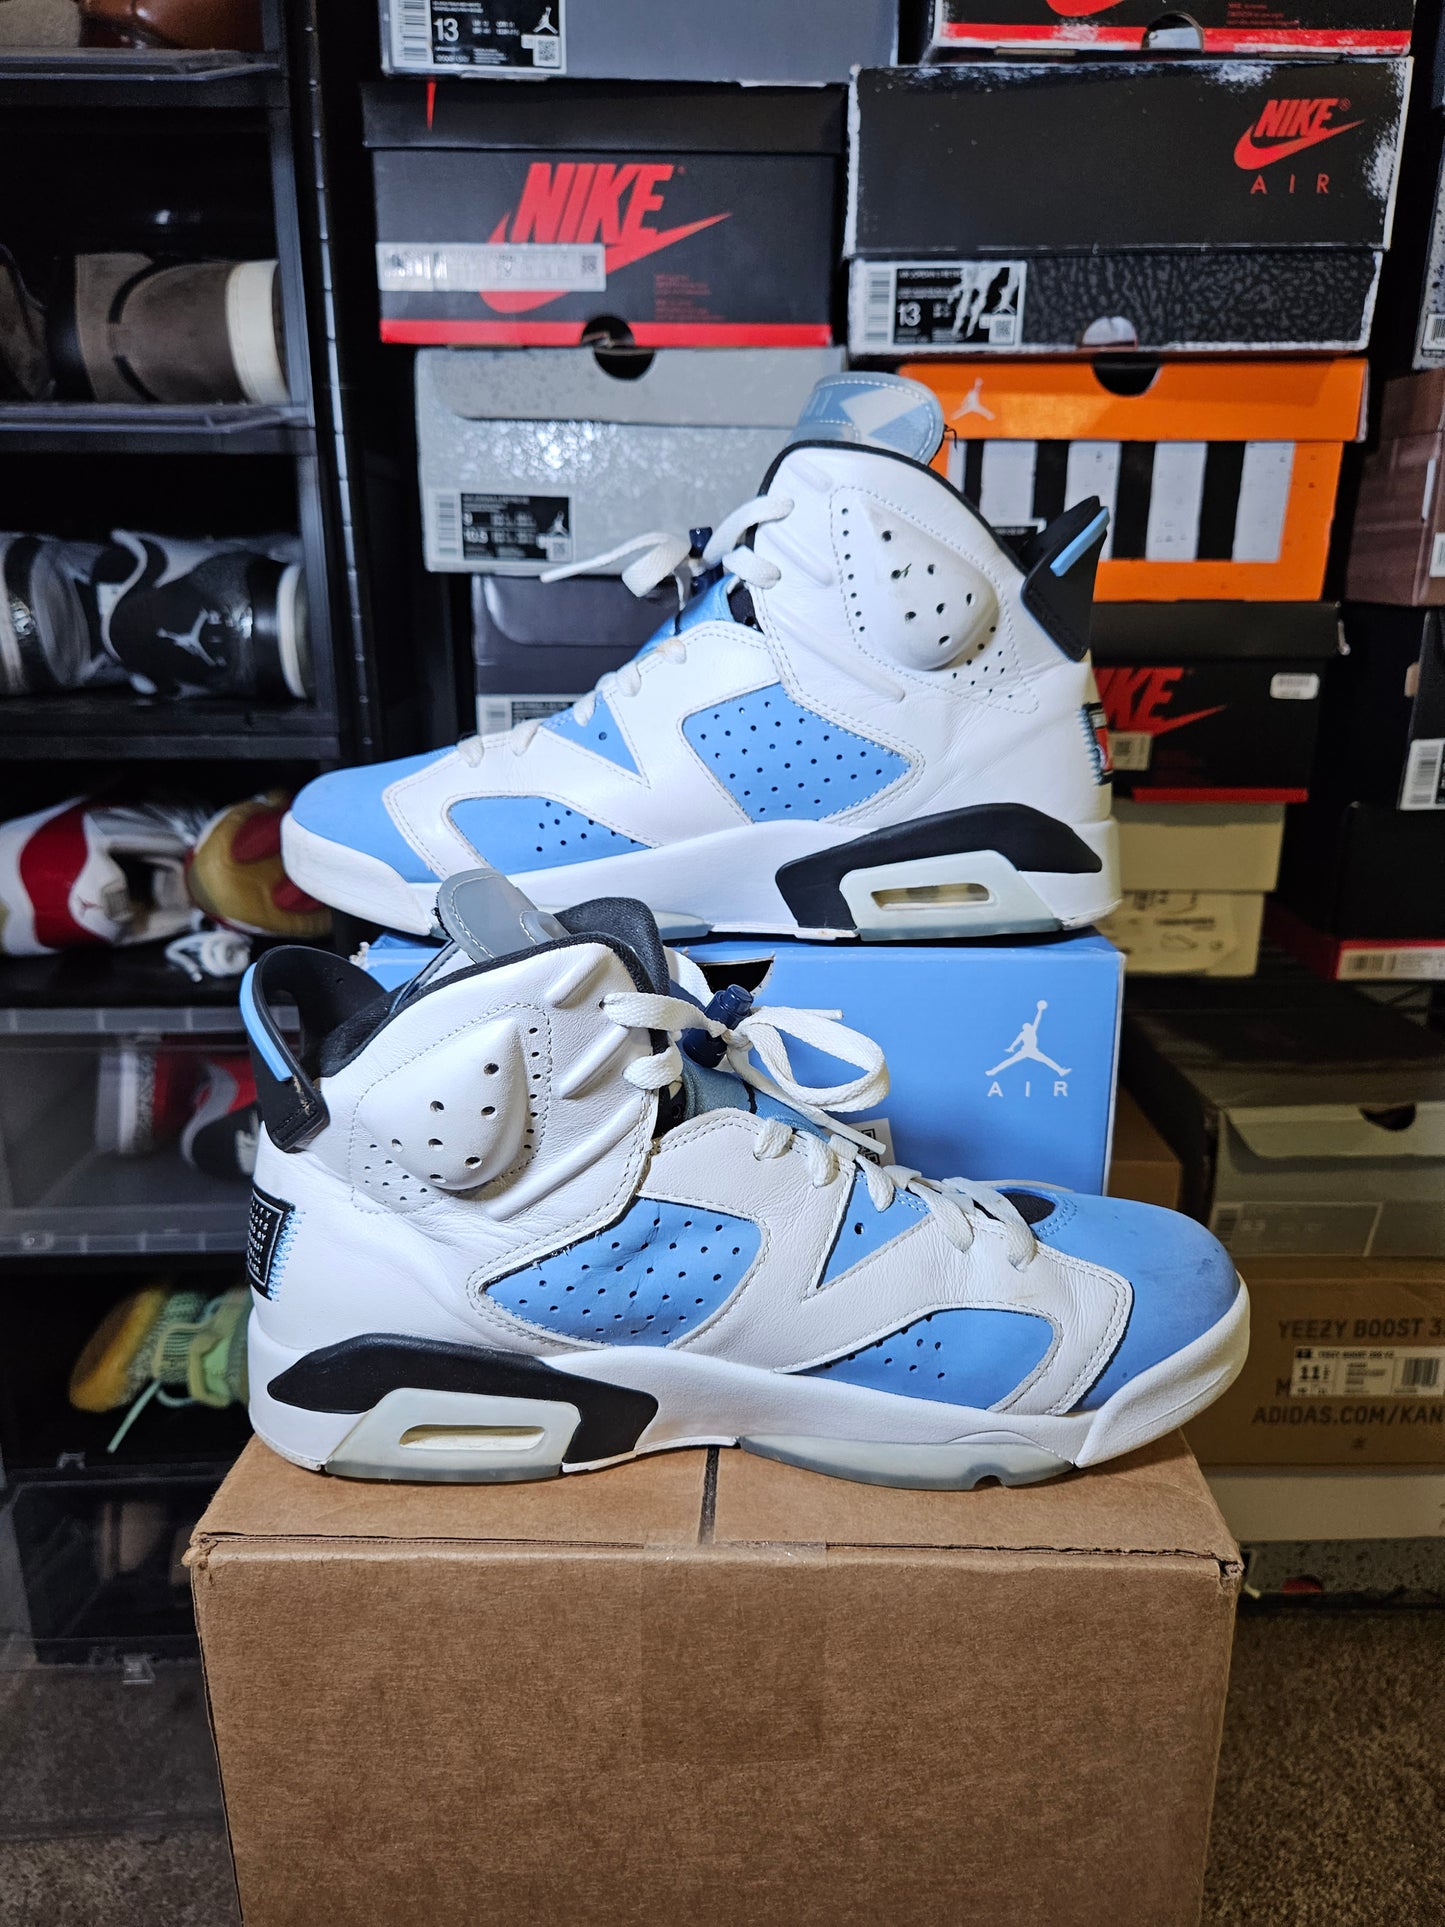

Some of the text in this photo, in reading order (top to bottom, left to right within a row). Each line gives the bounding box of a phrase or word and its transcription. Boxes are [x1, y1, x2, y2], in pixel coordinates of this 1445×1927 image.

[433, 17, 460, 43] 13
[1253, 98, 1339, 138] NIKE
[1250, 173, 1330, 195] AIR
[510, 162, 674, 244] NIKE
[897, 301, 922, 327] 13
[987, 1081, 1068, 1097] AIR
[1278, 1318, 1347, 1339] YEEZY
[1353, 1317, 1424, 1338] BOOST
